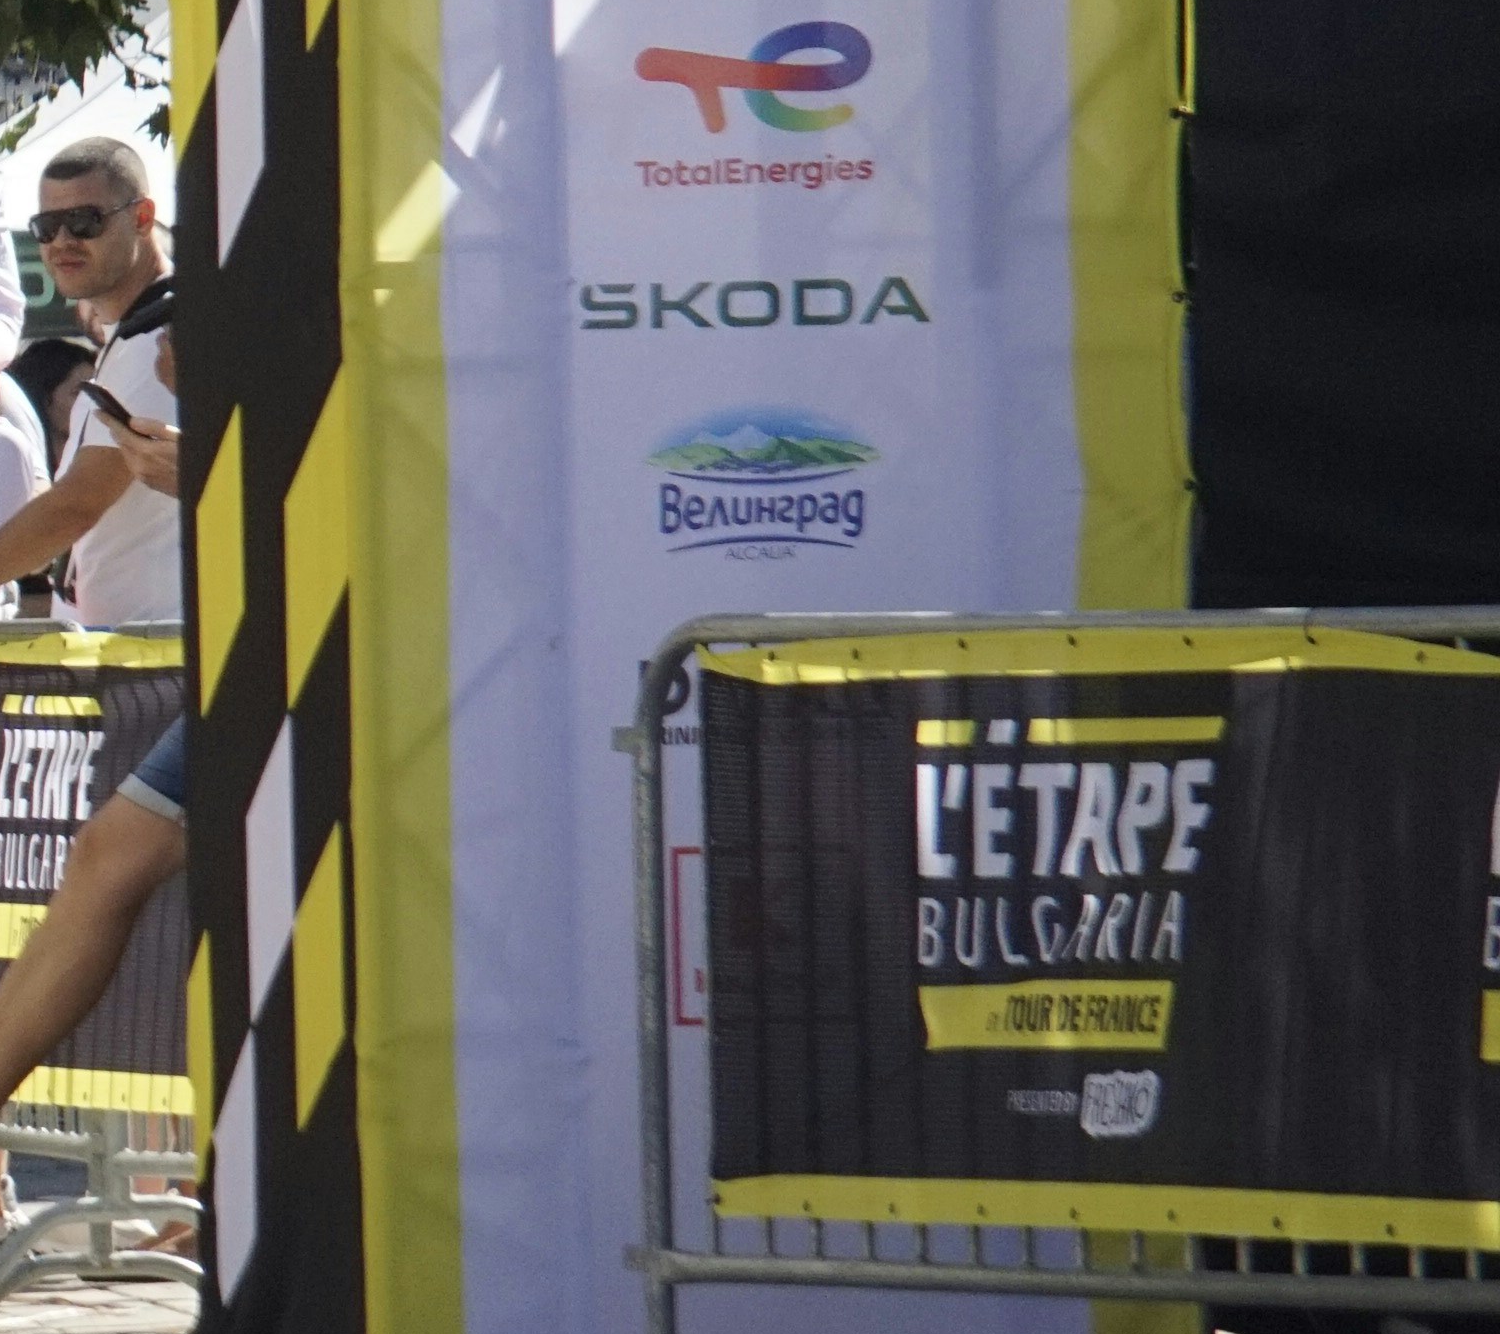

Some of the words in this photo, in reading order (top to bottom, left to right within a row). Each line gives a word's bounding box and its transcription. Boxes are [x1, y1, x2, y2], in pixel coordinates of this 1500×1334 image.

[634, 155, 875, 189] TotalEnergies
[660, 482, 865, 538] Велинград
[917, 889, 1185, 968] BULGARIA
[1004, 992, 1055, 1033] TOUR
[1085, 993, 1162, 1034] FRANCE
